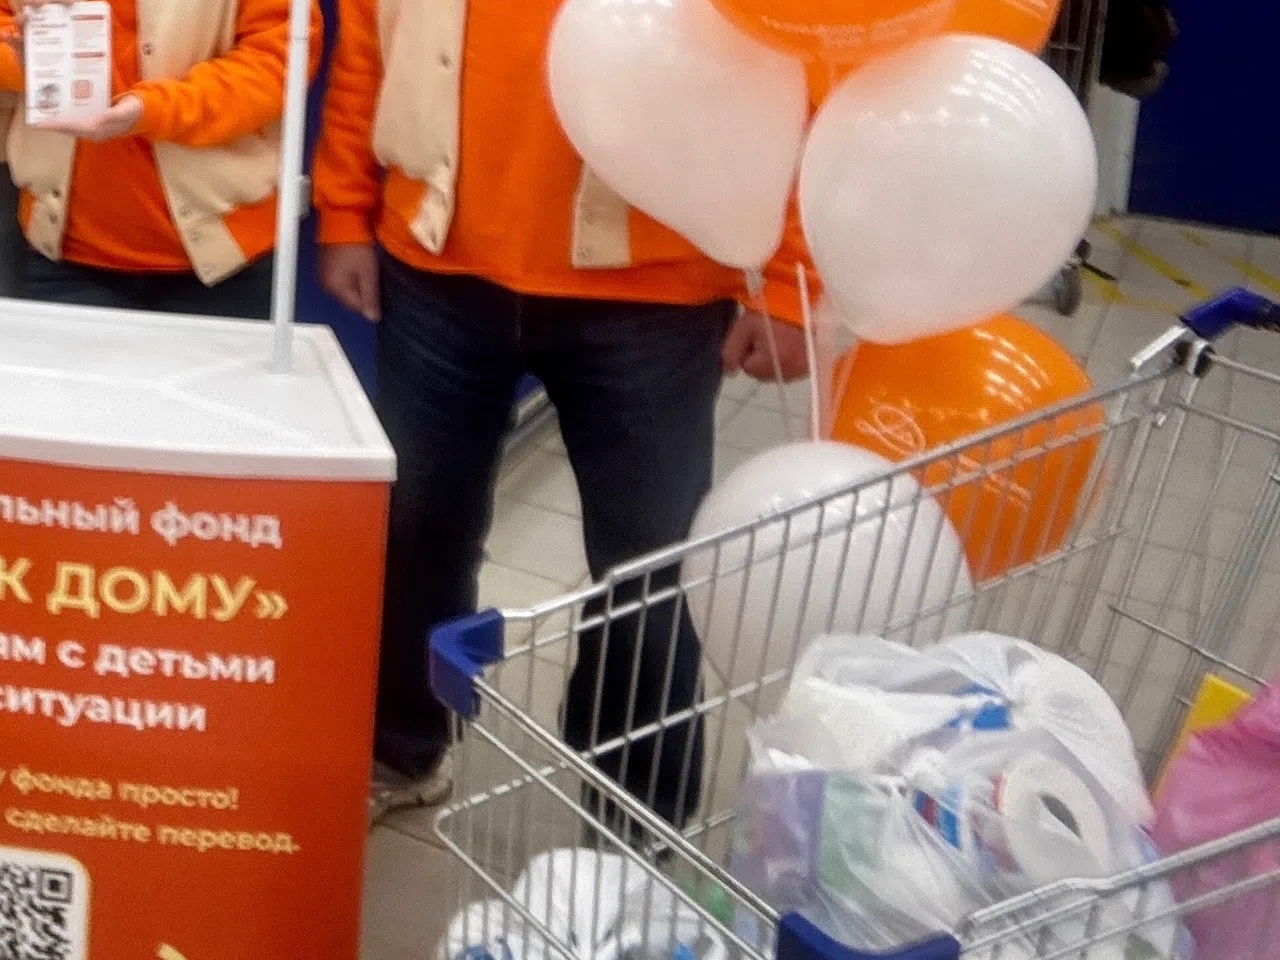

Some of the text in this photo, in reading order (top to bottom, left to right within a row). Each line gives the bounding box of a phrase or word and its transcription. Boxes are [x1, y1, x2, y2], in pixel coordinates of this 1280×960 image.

[150, 500, 283, 549] фонд
[46, 561, 289, 622] ДОМУ»
[55, 639, 87, 669] с
[93, 643, 276, 685] детьми
[9, 764, 113, 800] фонда
[117, 780, 240, 811] просто!
[4, 807, 152, 843] сделайте
[156, 825, 301, 855] перевод.
